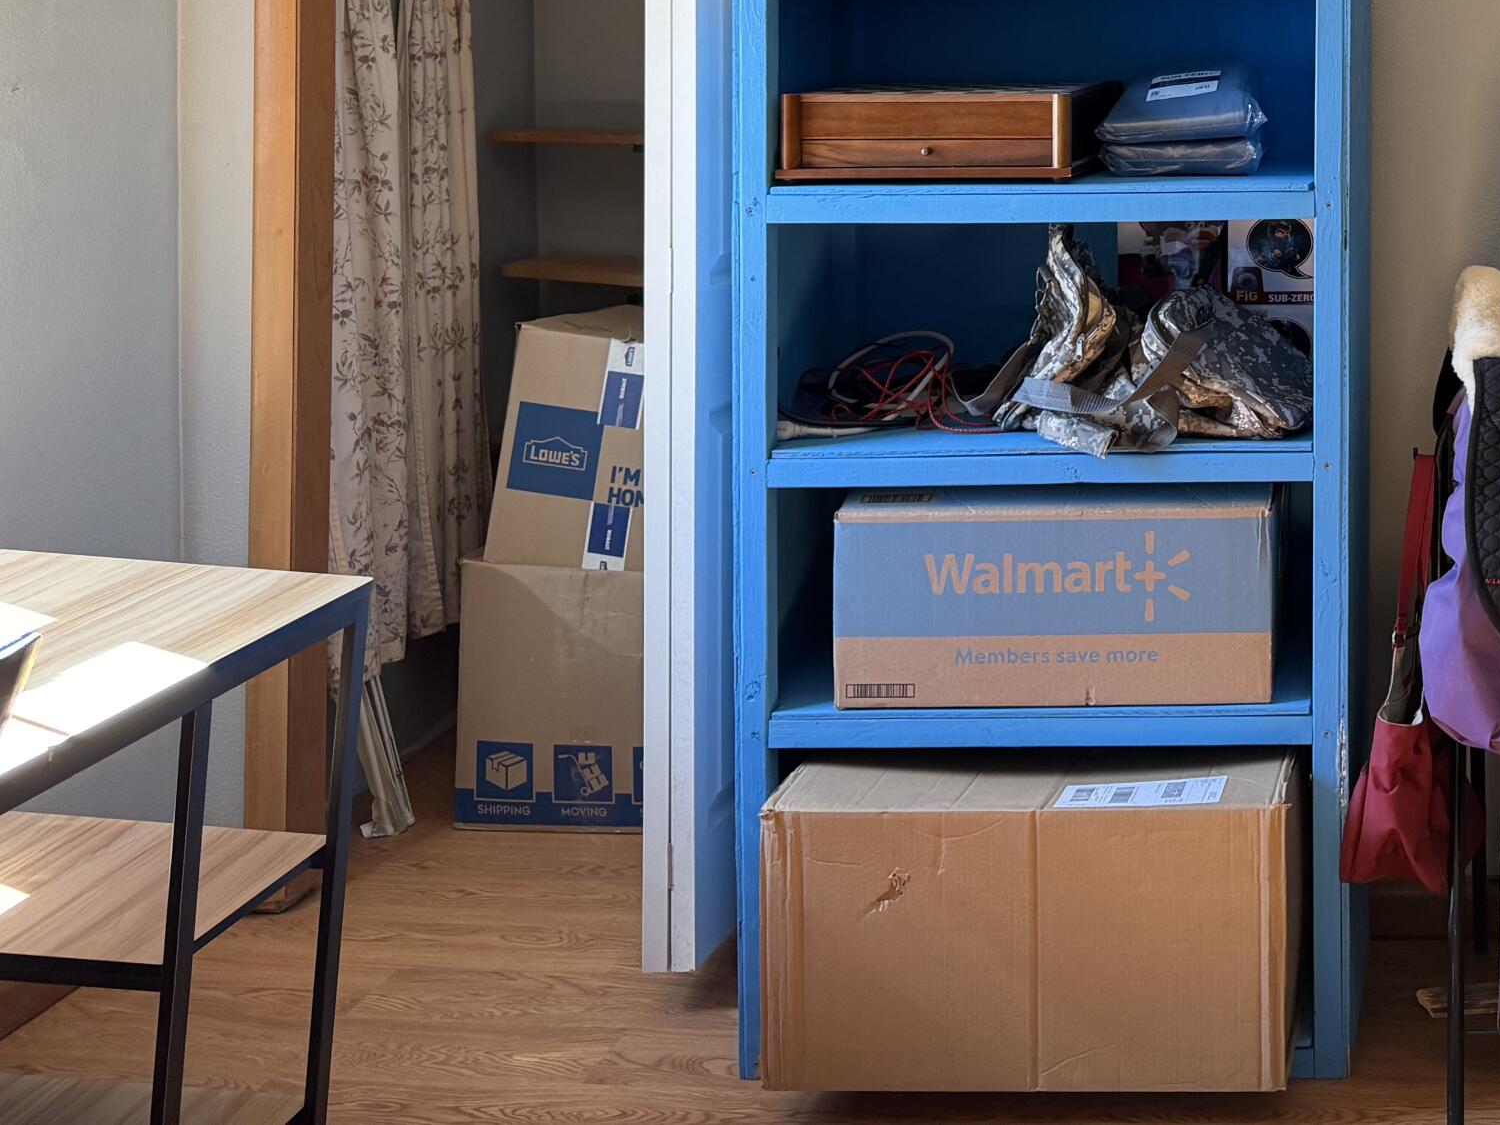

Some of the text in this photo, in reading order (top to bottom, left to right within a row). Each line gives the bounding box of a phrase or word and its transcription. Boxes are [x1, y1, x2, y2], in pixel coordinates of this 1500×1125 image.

[1236, 290, 1258, 302] FIG
[530, 444, 581, 467] LOWE'S
[610, 465, 642, 487] I'M
[954, 646, 1159, 665] Members save more
[477, 805, 531, 816] SHIPPING
[561, 807, 608, 818] MOVING
